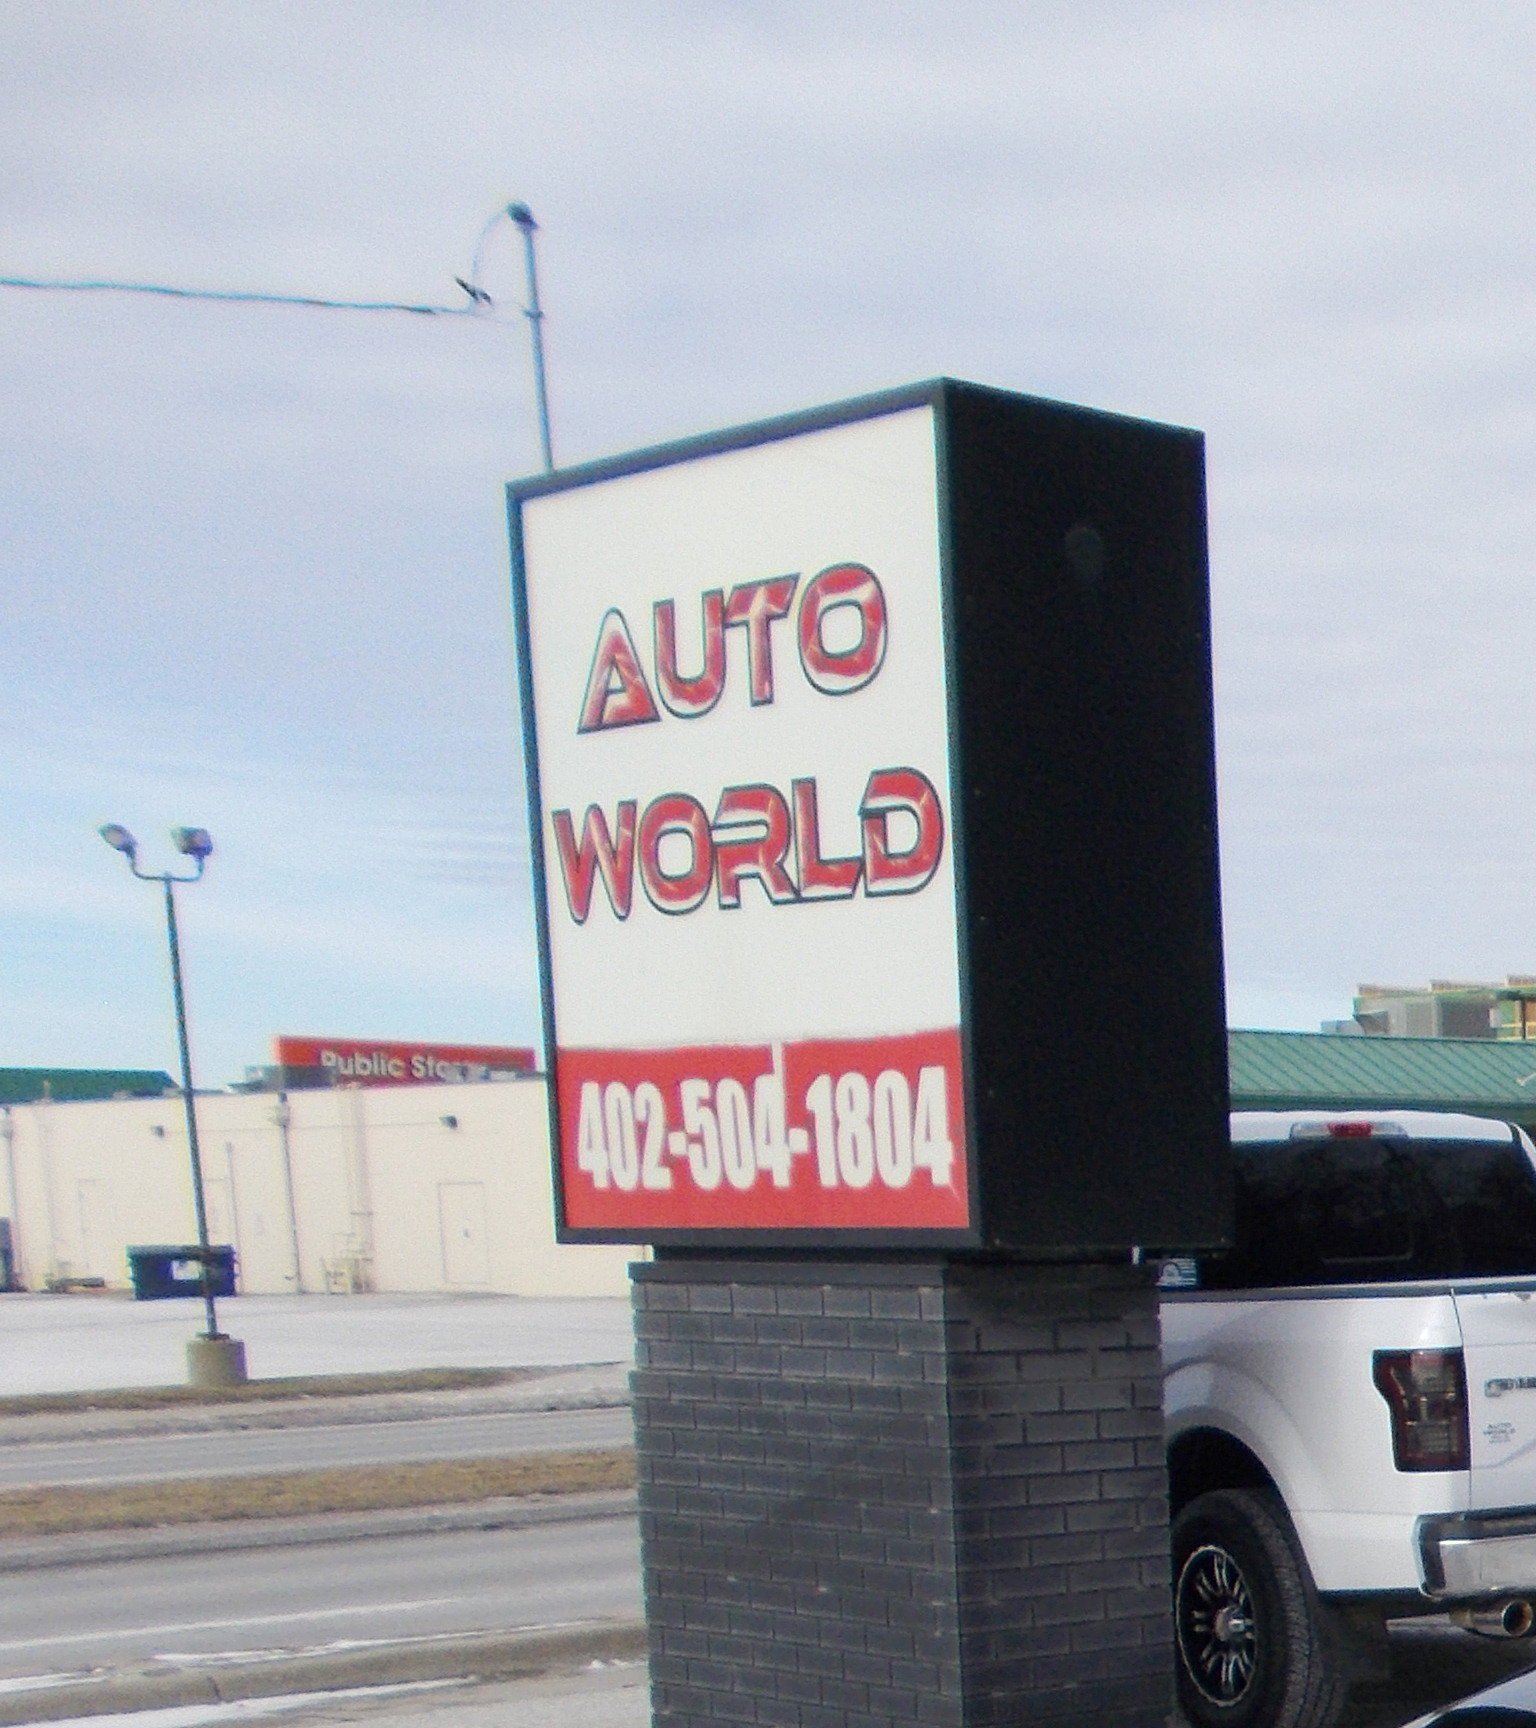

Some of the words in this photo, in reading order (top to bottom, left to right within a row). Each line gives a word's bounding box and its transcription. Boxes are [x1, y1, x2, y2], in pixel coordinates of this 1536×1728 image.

[576, 561, 888, 735] AUTO
[551, 766, 945, 926] WORLD
[320, 1050, 405, 1079] Public
[577, 1064, 954, 1191] 402-504-1804
